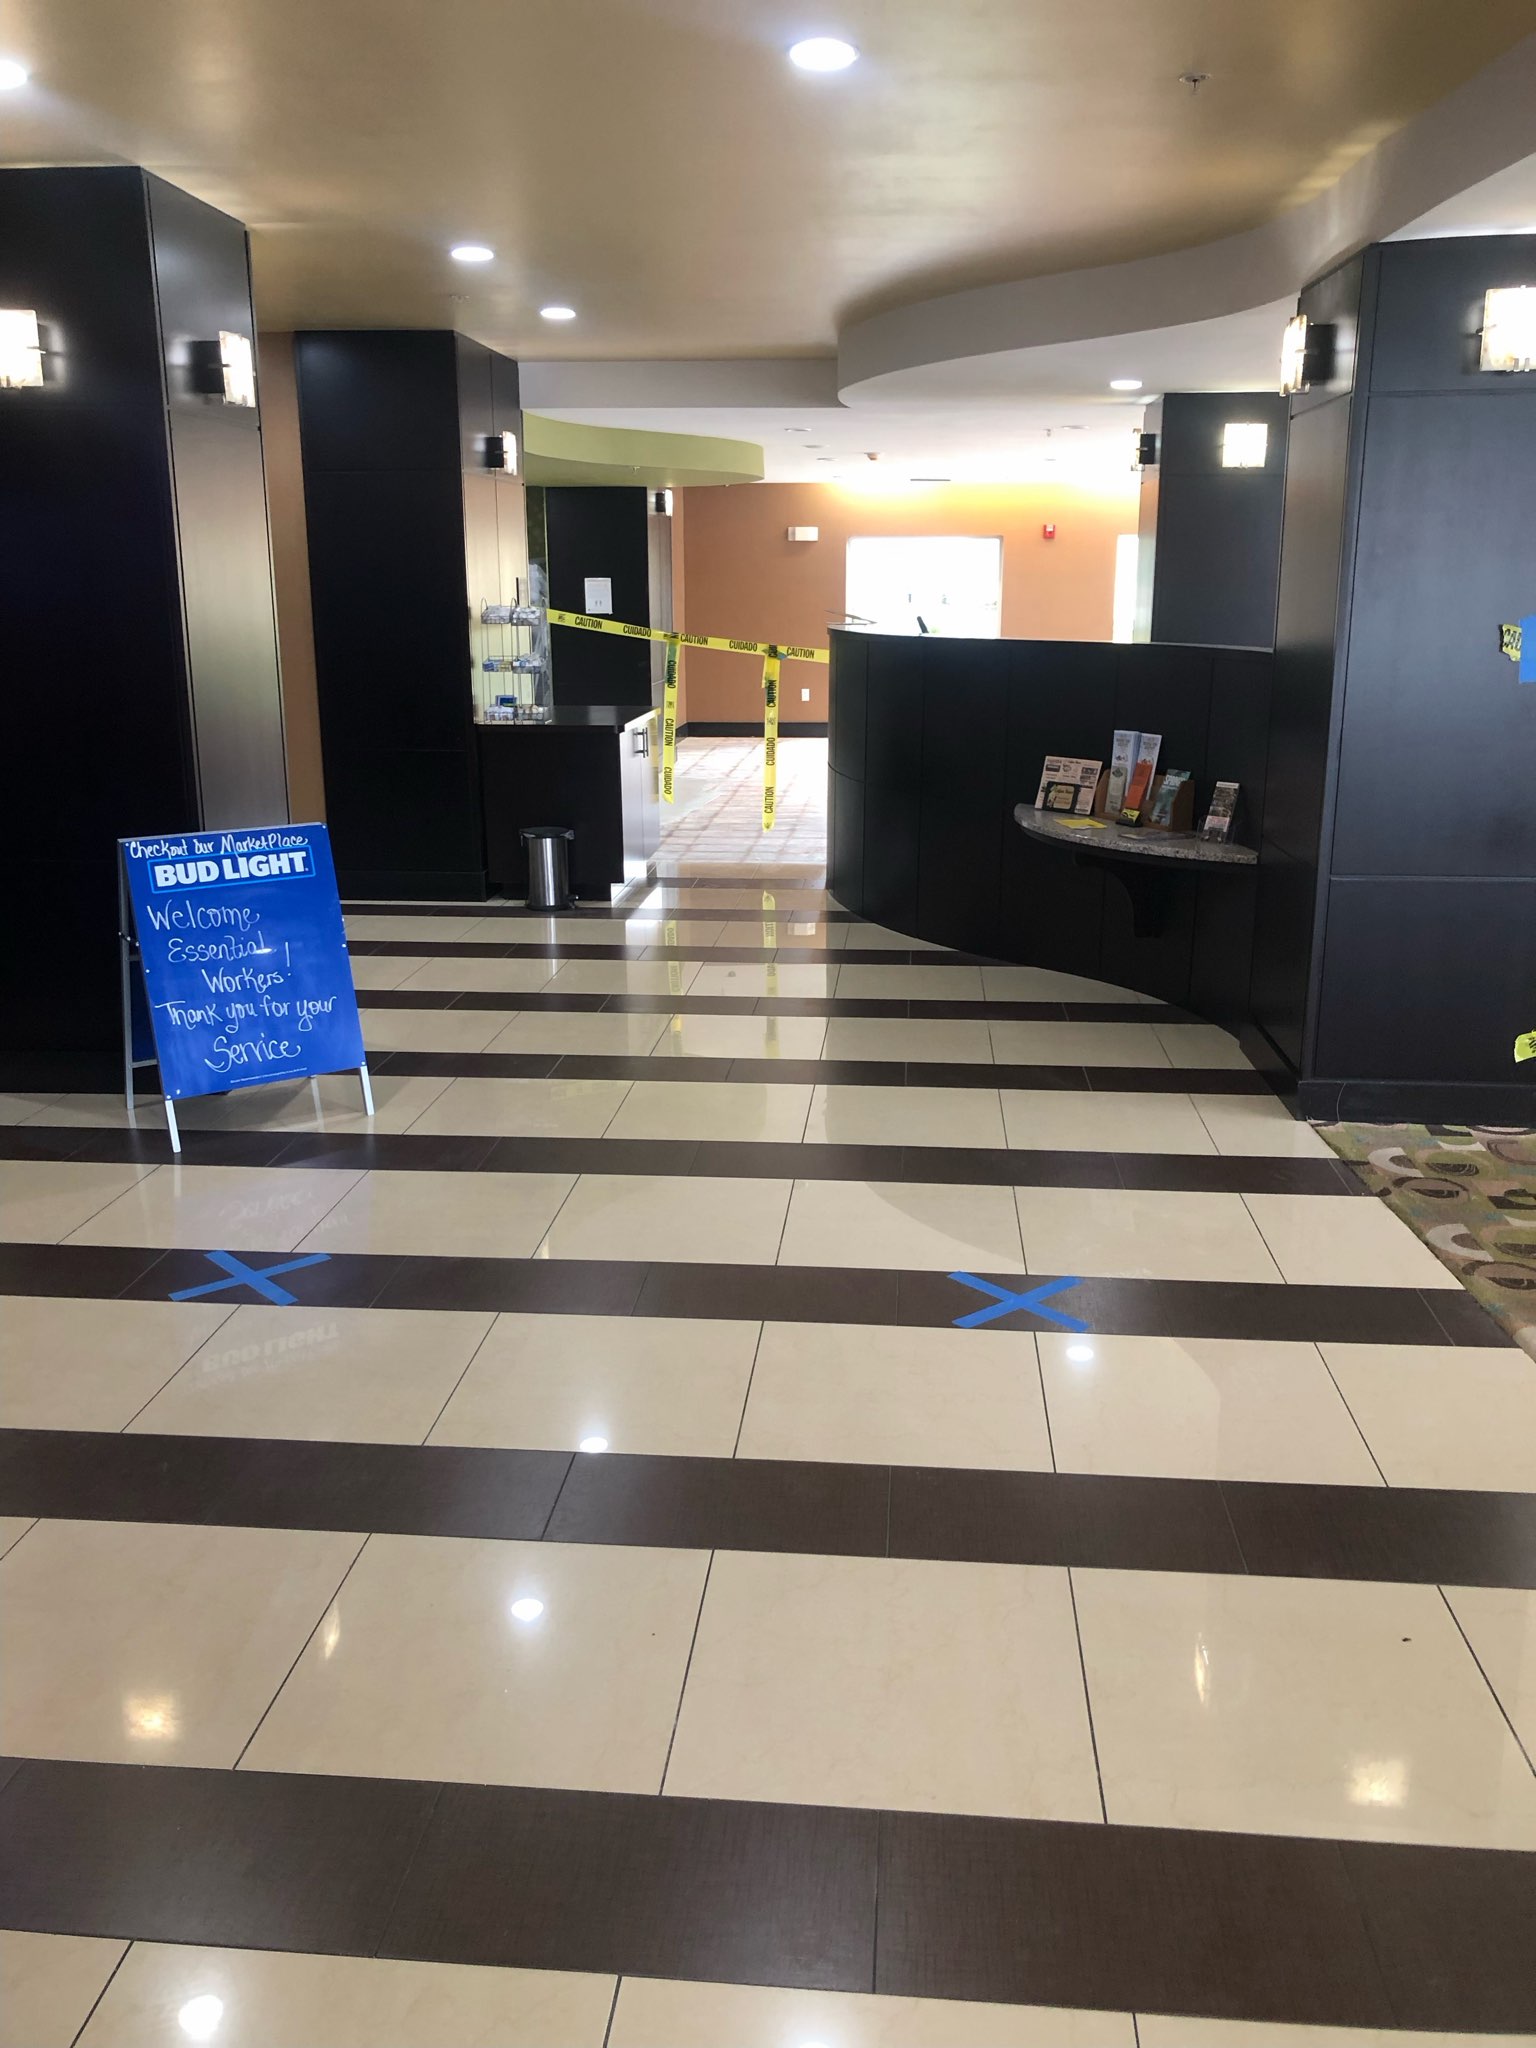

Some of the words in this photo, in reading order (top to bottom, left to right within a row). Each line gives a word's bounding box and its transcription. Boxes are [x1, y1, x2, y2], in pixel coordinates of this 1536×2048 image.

[575, 616, 602, 629] CAUTION
[623, 625, 651, 638] CUIDADO
[680, 634, 708, 645] CAUTION
[729, 640, 758, 652] CUIDADO
[786, 647, 815, 659] CAUTION
[767, 679, 777, 707] CAUTION
[665, 718, 674, 747] CAUTION
[766, 737, 775, 766] CUIDADO
[663, 766, 672, 795] CUIDADO
[764, 786, 774, 814] CAUTION
[154, 860, 219, 887] BUD
[222, 851, 307, 880] LIGHT
[147, 899, 260, 930] Welcome
[168, 931, 267, 963] Essential
[155, 1000, 222, 1030] Thank
[226, 1003, 256, 1033] you
[260, 995, 289, 1017] for
[297, 996, 336, 1031] your
[205, 1033, 301, 1072] Service
